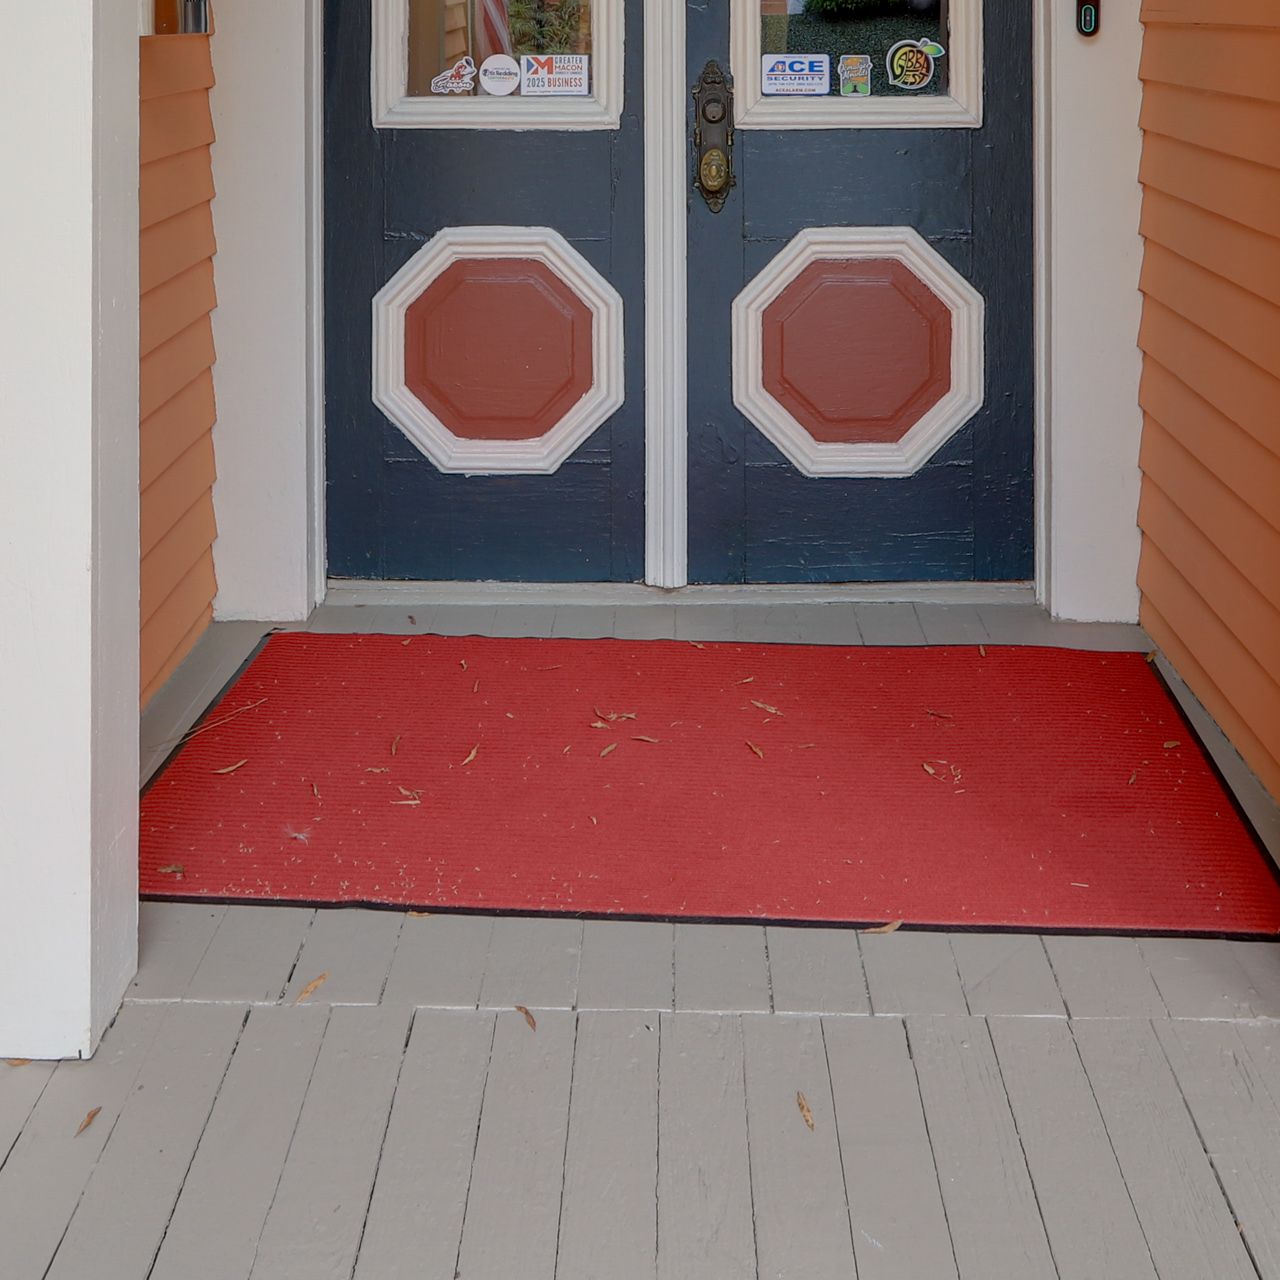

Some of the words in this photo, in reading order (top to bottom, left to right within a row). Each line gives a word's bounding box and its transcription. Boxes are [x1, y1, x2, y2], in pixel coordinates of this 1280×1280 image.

[554, 56, 583, 64] GREATER
[768, 60, 824, 72] ACE
[527, 77, 545, 88] 2025
[548, 77, 583, 88] BUSINESS
